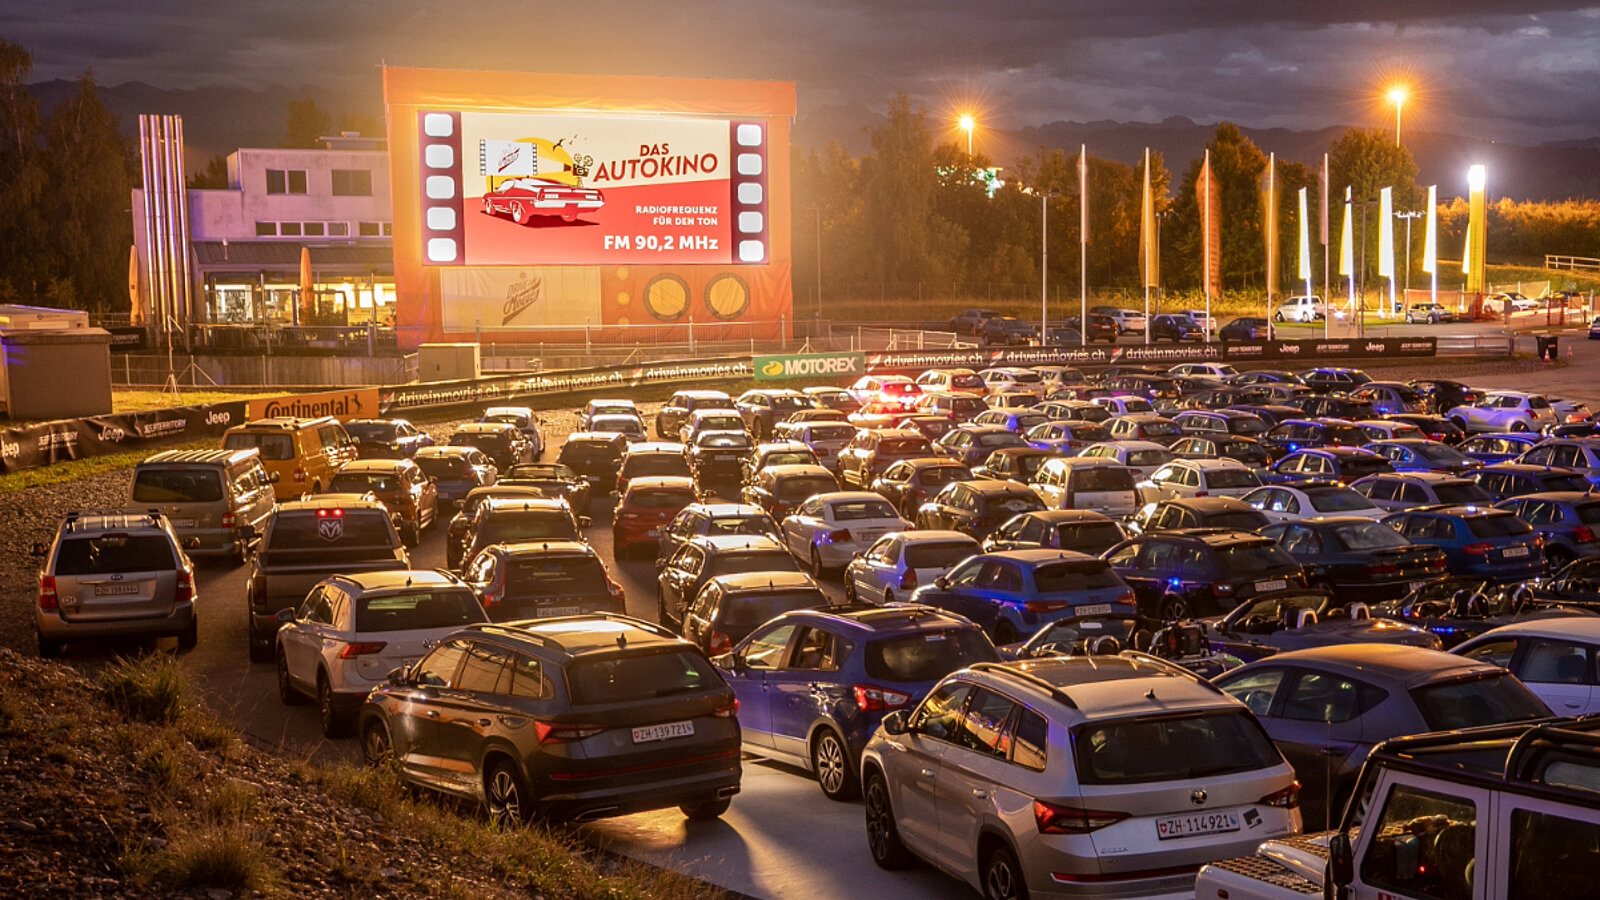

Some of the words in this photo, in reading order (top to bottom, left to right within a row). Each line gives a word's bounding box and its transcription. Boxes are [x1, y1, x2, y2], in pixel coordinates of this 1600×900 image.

[639, 143, 669, 156] DAS
[593, 153, 718, 182] AUTOKINO
[635, 205, 718, 214] RADIOFREQUENZ
[653, 216, 673, 226] FÜR
[675, 217, 694, 226] DEN
[696, 217, 718, 226] TON
[604, 235, 630, 250] FM
[635, 235, 674, 251] 90,2
[679, 235, 719, 250] MHz
[1126, 345, 1218, 359] driveinmovies.ch
[1279, 343, 1300, 354] Jeep
[1365, 341, 1385, 352] Jeep
[883, 352, 983, 367] driveinmovies.ch
[1006, 348, 1106, 363] driveinmovies.ch
[646, 362, 747, 379] driveinmovies.ch
[784, 357, 857, 375] MOTOREX
[524, 371, 623, 393] driveinmovies.ch
[399, 384, 501, 406] driveinmovies.ch
[264, 395, 349, 419] Continental
[205, 411, 230, 426] Jeep
[97, 425, 125, 443] Jeep
